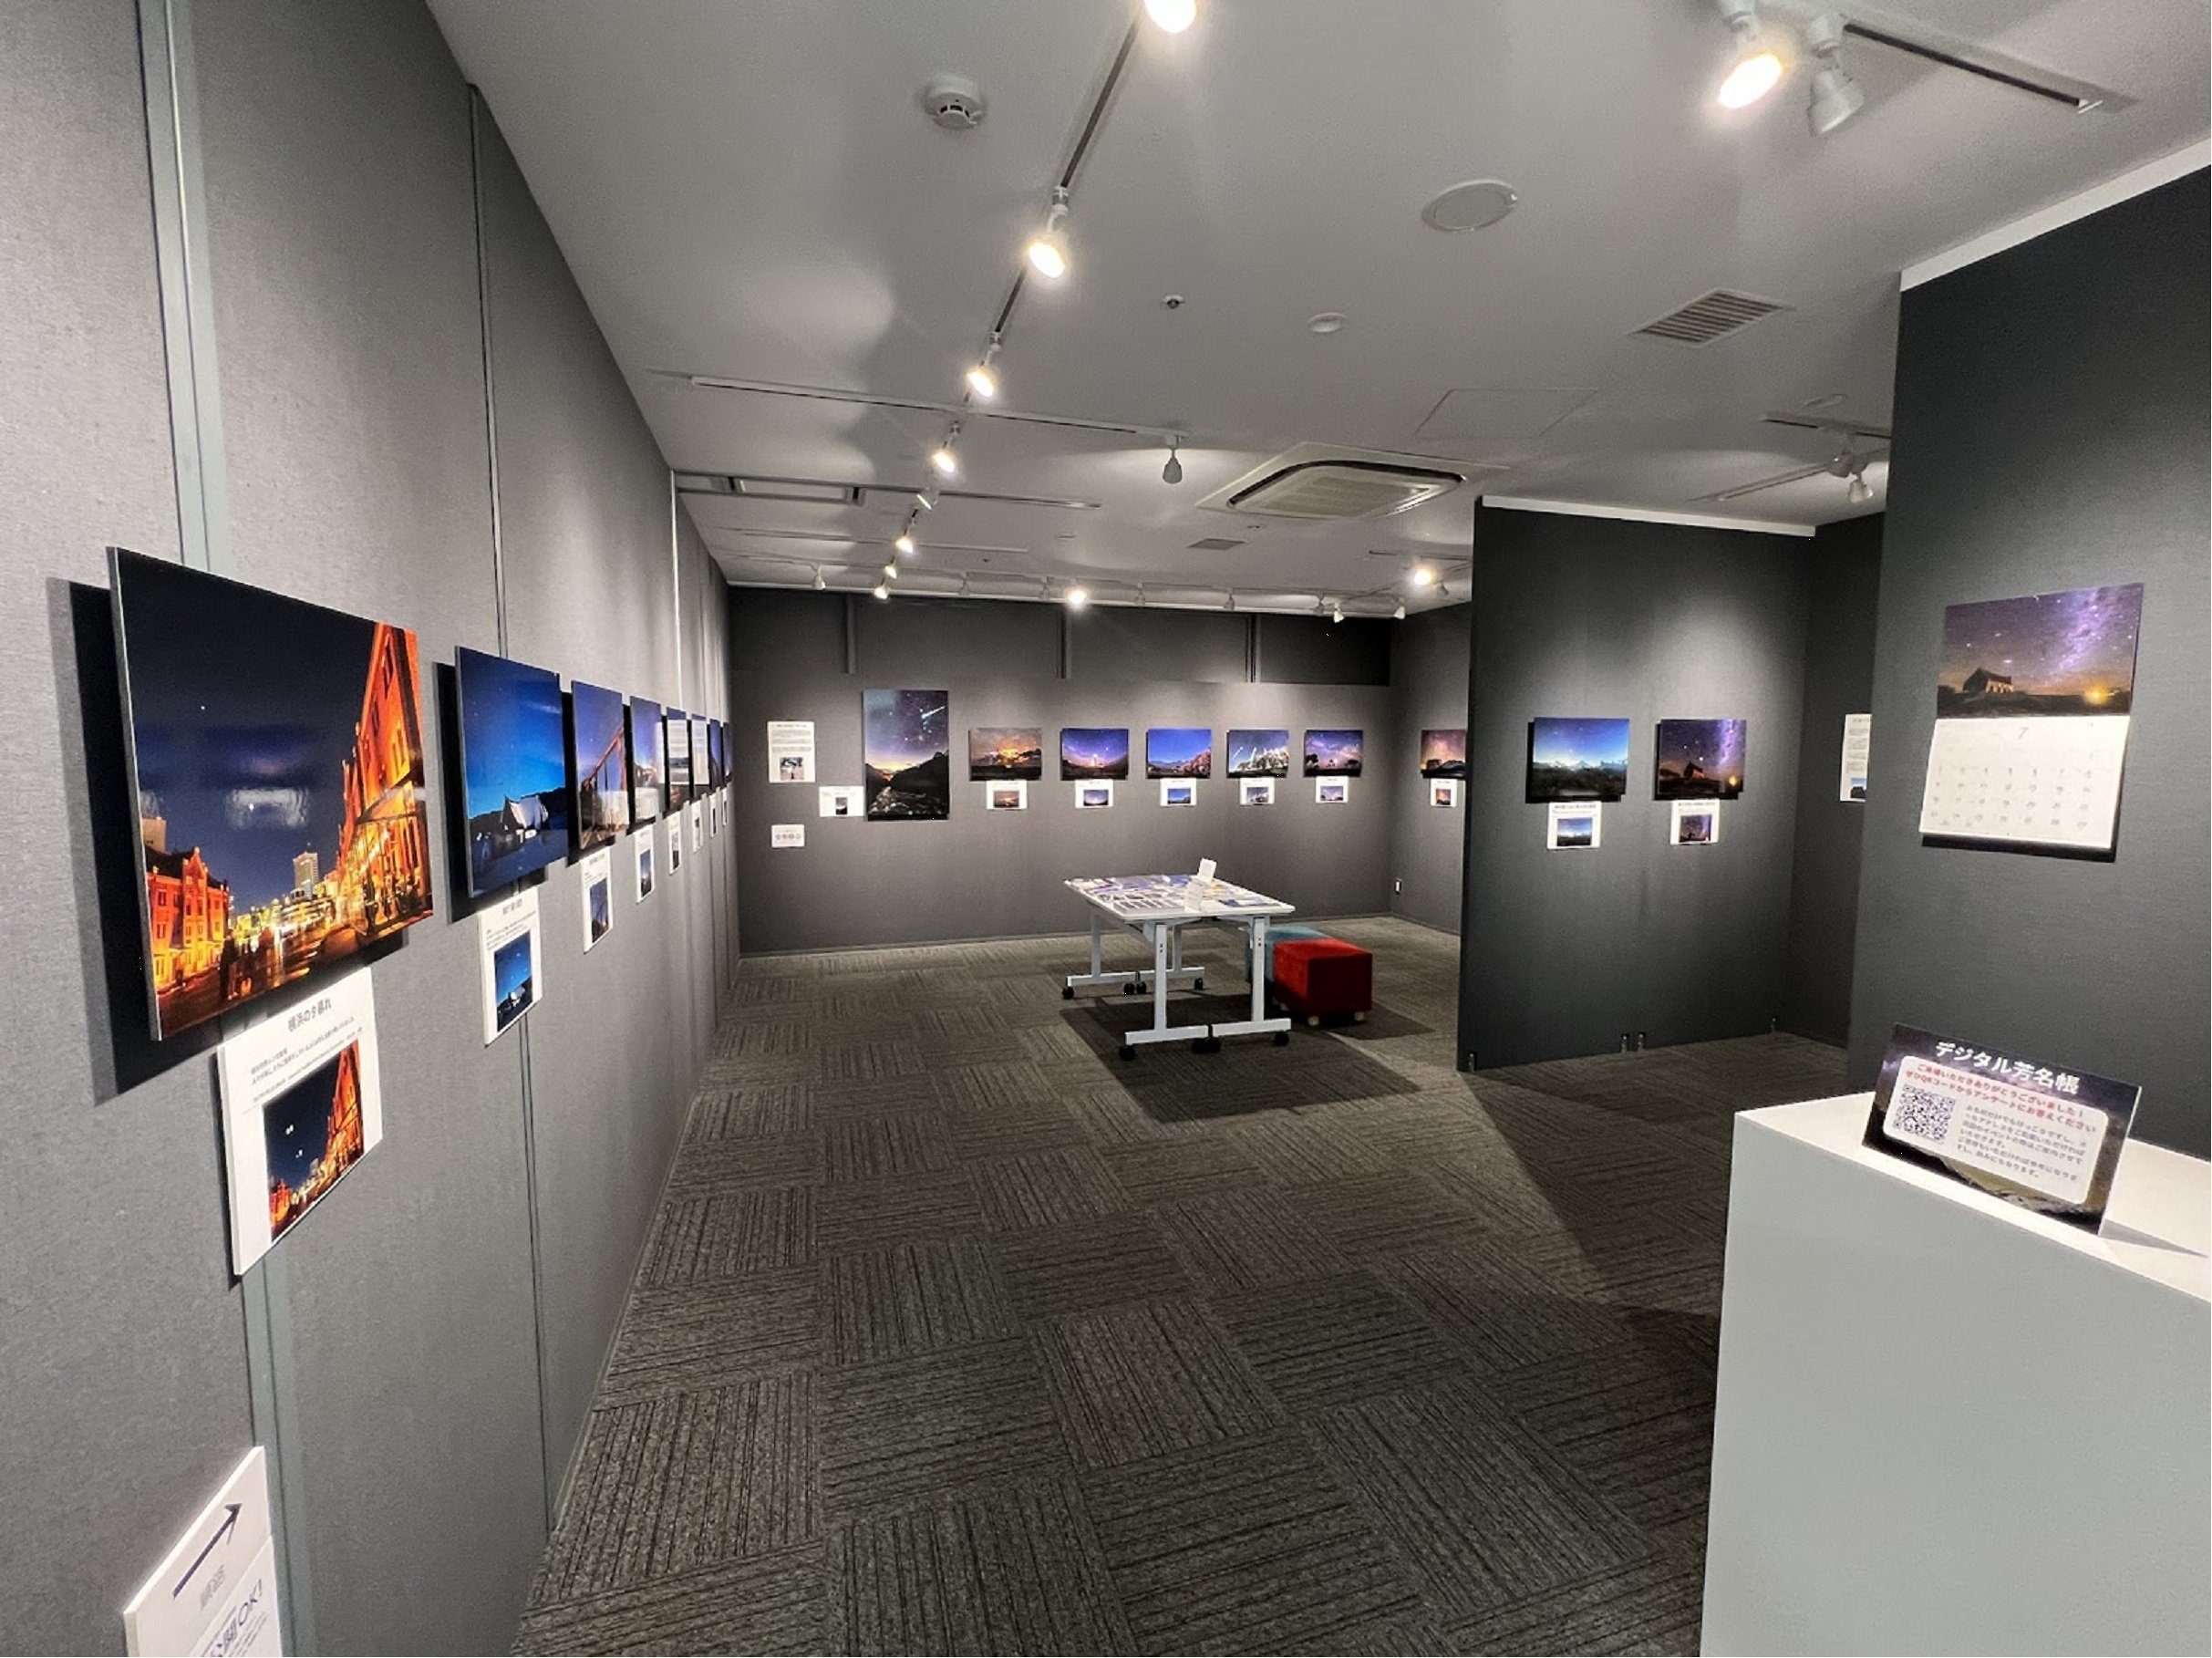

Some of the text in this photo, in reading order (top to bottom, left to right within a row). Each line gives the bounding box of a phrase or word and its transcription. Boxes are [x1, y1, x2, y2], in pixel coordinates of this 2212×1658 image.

[2019, 727, 2029, 740] 7
[1936, 1041, 2080, 1094] デジタル芳名帳
